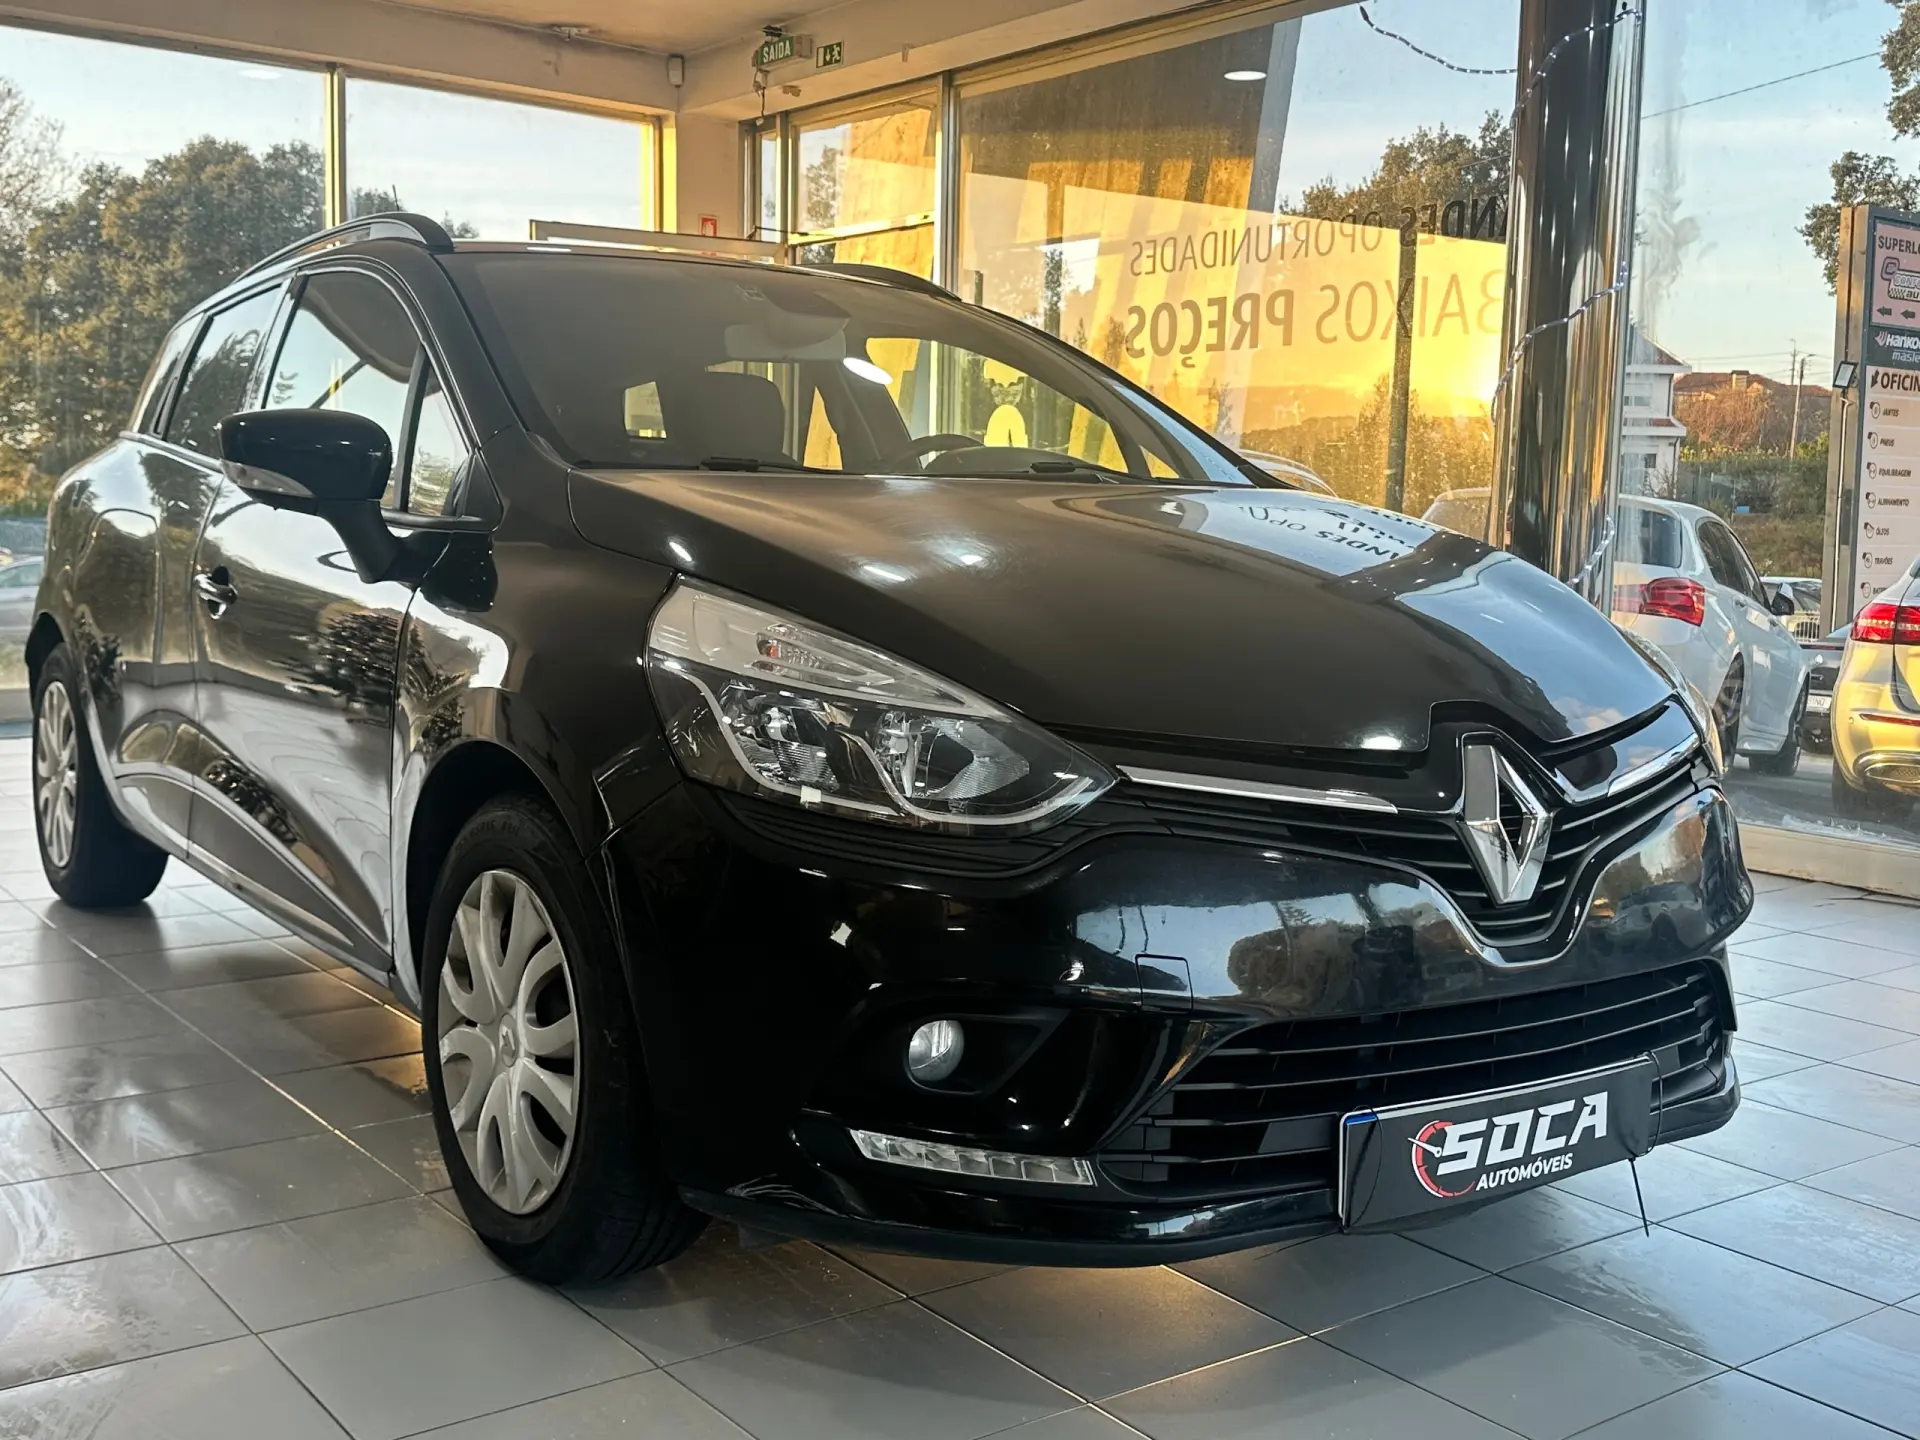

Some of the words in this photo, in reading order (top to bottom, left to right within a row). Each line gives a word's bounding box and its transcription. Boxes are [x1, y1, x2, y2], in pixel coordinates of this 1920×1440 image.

[762, 40, 791, 63] SAIDA
[1436, 1091, 1608, 1176] SOCA
[1475, 1152, 1573, 1192] AUTOMÓVEIS
